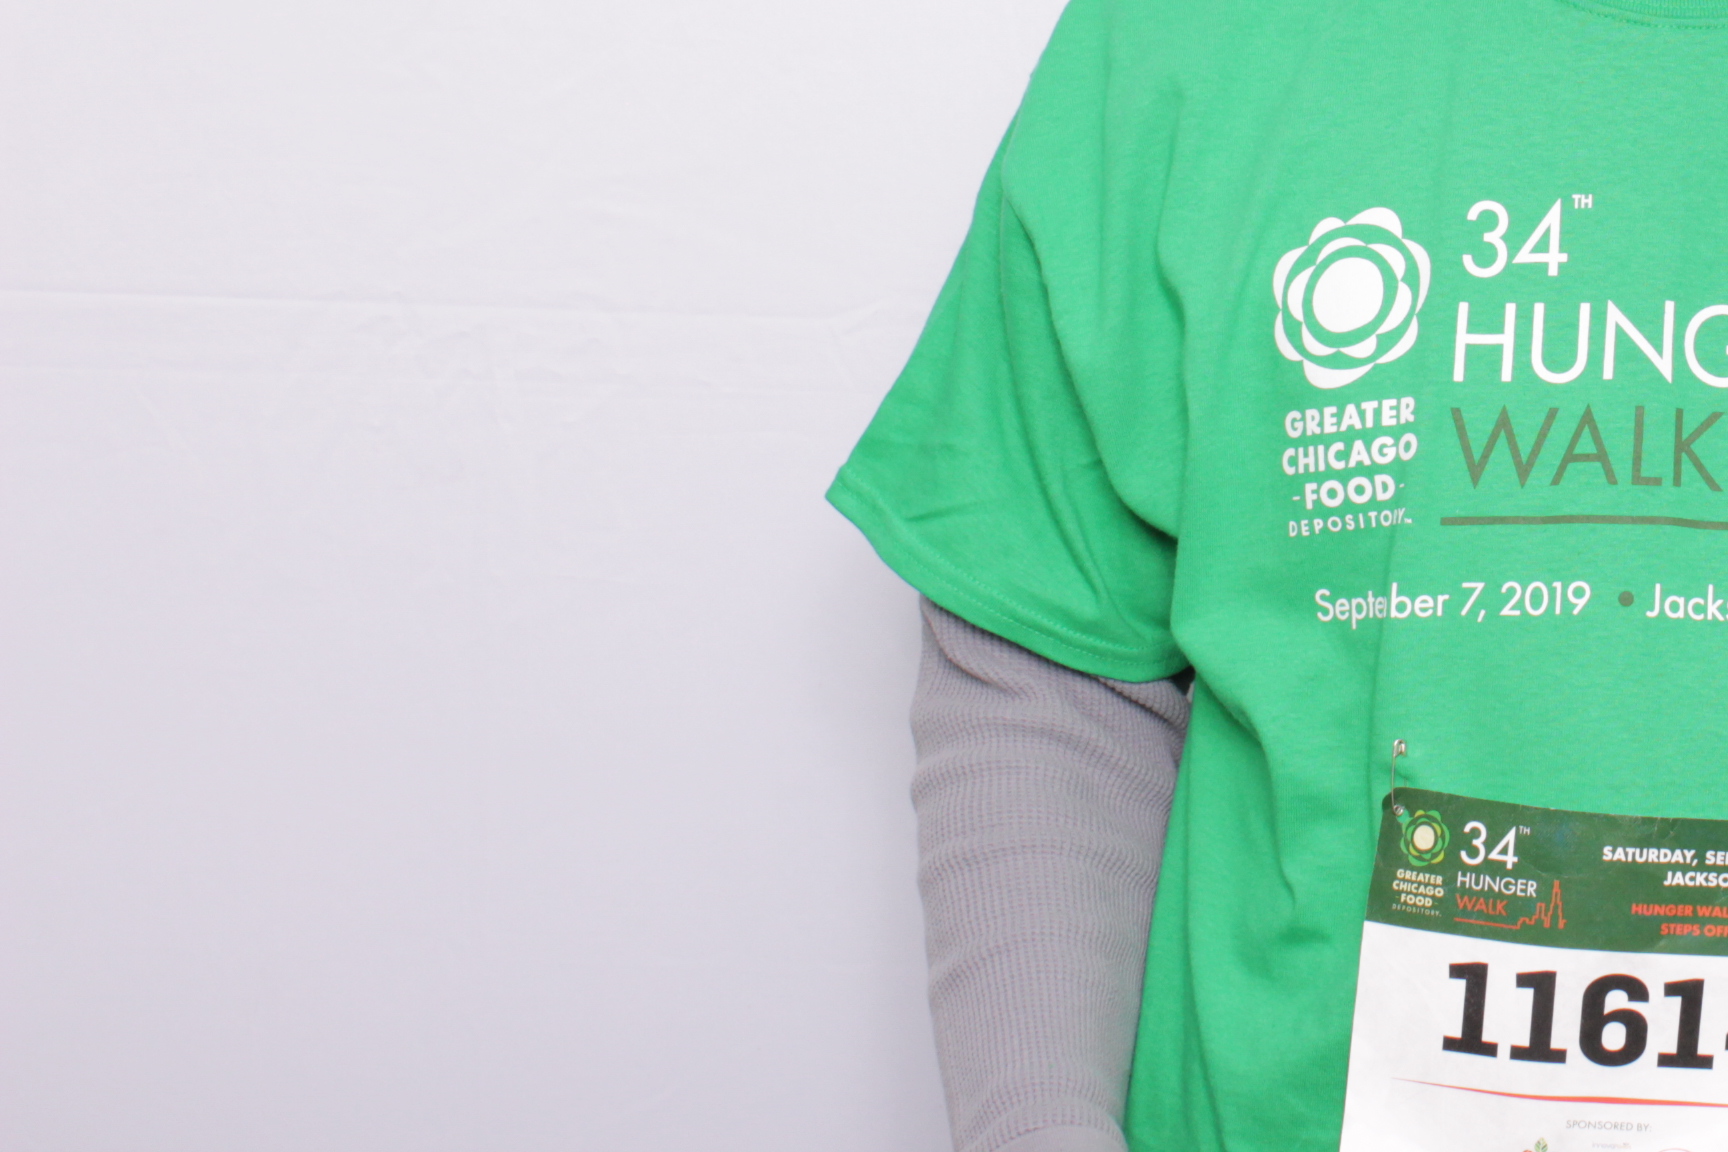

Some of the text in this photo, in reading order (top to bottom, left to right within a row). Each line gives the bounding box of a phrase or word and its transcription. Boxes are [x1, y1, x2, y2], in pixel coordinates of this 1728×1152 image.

[1284, 396, 1416, 439] GREATER
[1281, 432, 1418, 476] CHICAGO
[1449, 403, 1727, 493] WALK
[1314, 582, 1450, 630] Septeber
[1460, 582, 1486, 623] 7,
[1499, 580, 1592, 617] 2019
[1602, 845, 1699, 867] SATURDAY,
[1392, 880, 1445, 897] CHICAGO
[1396, 868, 1444, 886] GREATER
[1456, 870, 1538, 898] HUNGER
[1455, 893, 1509, 917] WALK
[1630, 903, 1694, 918] HUNGER
[1660, 922, 1701, 937] STEPS
[1565, 1119, 1634, 1132] SPONSORED
